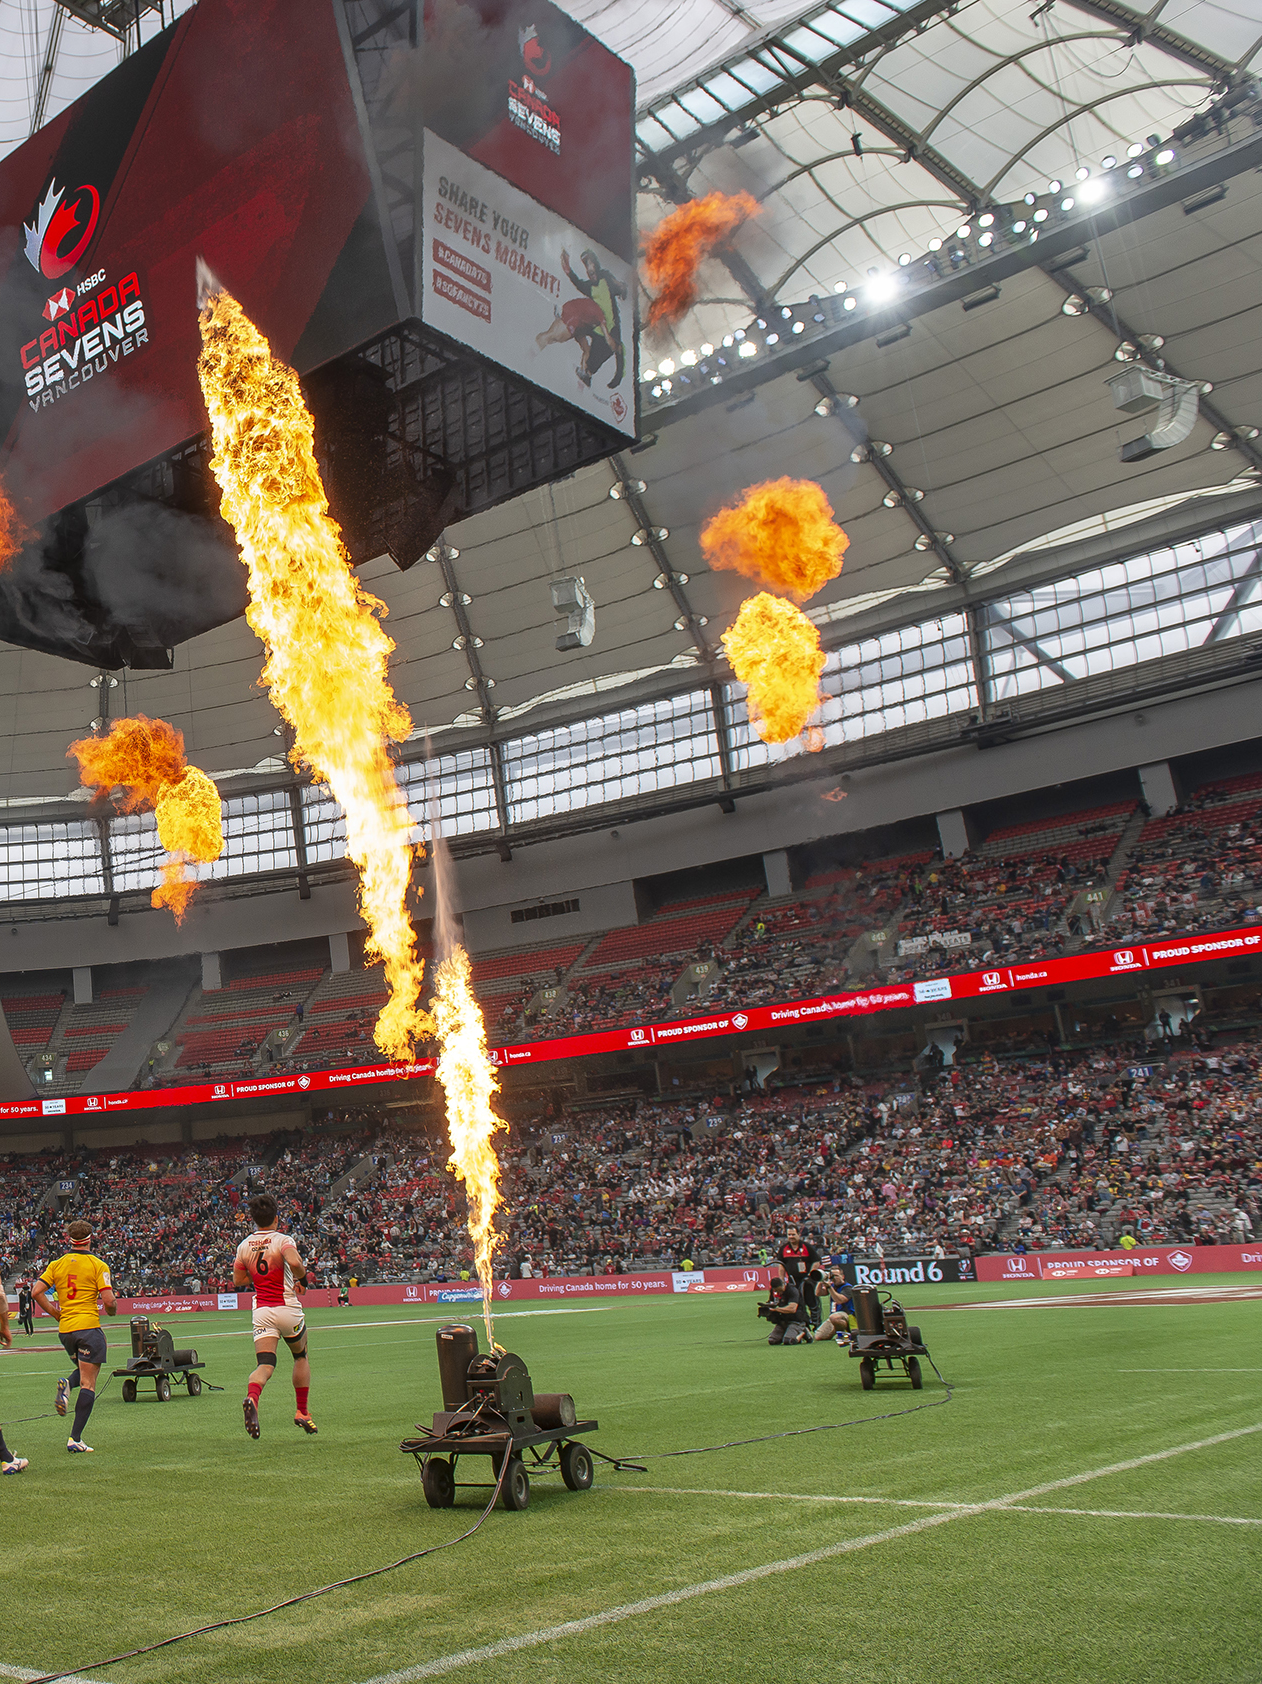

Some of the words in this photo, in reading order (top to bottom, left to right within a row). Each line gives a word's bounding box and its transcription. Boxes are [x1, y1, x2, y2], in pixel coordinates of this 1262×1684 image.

[508, 96, 561, 146] SEVENS
[439, 176, 488, 224] SHARE
[493, 210, 529, 250] YOUR
[434, 202, 491, 255] SEVENS
[495, 241, 561, 298] MOMENT!
[77, 268, 106, 296] HSBC
[20, 272, 140, 370] CANADA
[25, 300, 145, 396] SEVENS
[29, 328, 149, 413] VANCOUVER
[1087, 892, 1104, 901] 441
[1153, 948, 1190, 960] PROUD
[1192, 939, 1244, 953] SPONSOR
[1245, 935, 1261, 945] OF
[1110, 963, 1142, 972] HONDA
[1016, 971, 1048, 981] honda.ca
[979, 984, 1008, 992] HONDA
[771, 1010, 800, 1021] Driving
[657, 1028, 682, 1038] PROUD
[684, 1023, 718, 1034] SPONSOR
[719, 1020, 729, 1028] OF
[329, 1074, 351, 1083] Driving
[352, 1071, 376, 1080] Canada
[1131, 1067, 1150, 1078] 241
[258, 1082, 286, 1091] SPONSOR
[287, 1080, 295, 1088] OF
[0, 1106, 9, 1114] for
[20, 1105, 38, 1113] years.
[61, 1182, 73, 1190] 234
[256, 1252, 269, 1276] 6
[1143, 1257, 1159, 1267] OF
[855, 1262, 925, 1284] Round
[927, 1261, 943, 1283] 6
[67, 1274, 78, 1300] 5
[539, 1284, 564, 1294] Driving
[566, 1282, 594, 1292] Canada
[595, 1281, 617, 1291] home
[618, 1281, 629, 1290] for
[631, 1281, 642, 1289] 50
[643, 1281, 668, 1291] years.
